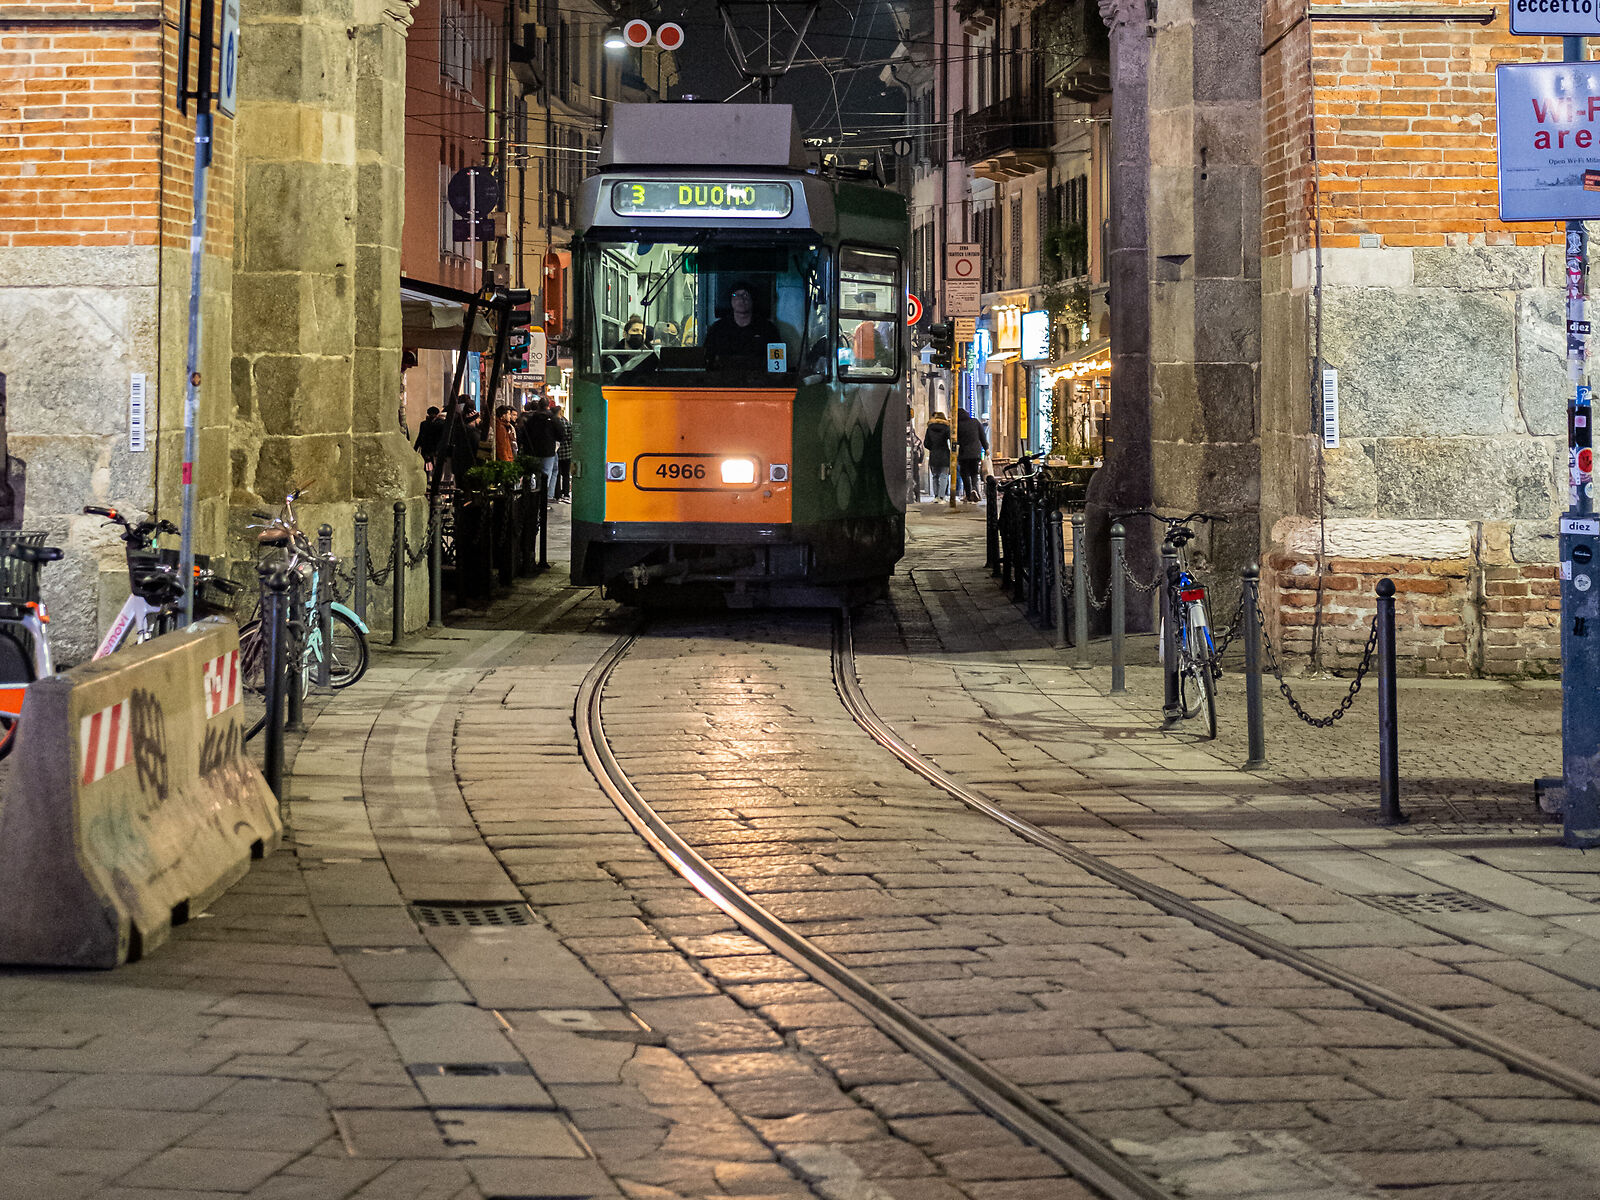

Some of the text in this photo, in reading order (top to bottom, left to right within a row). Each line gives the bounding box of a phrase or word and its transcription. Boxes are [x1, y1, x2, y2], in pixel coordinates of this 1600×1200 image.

[1534, 129, 1600, 150] are
[631, 184, 646, 205] 3
[907, 302, 915, 317] 0
[1569, 321, 1590, 333] diez
[774, 349, 780, 359] 6
[774, 360, 780, 371] 3
[655, 463, 706, 480] 4966
[1568, 521, 1591, 532] diez
